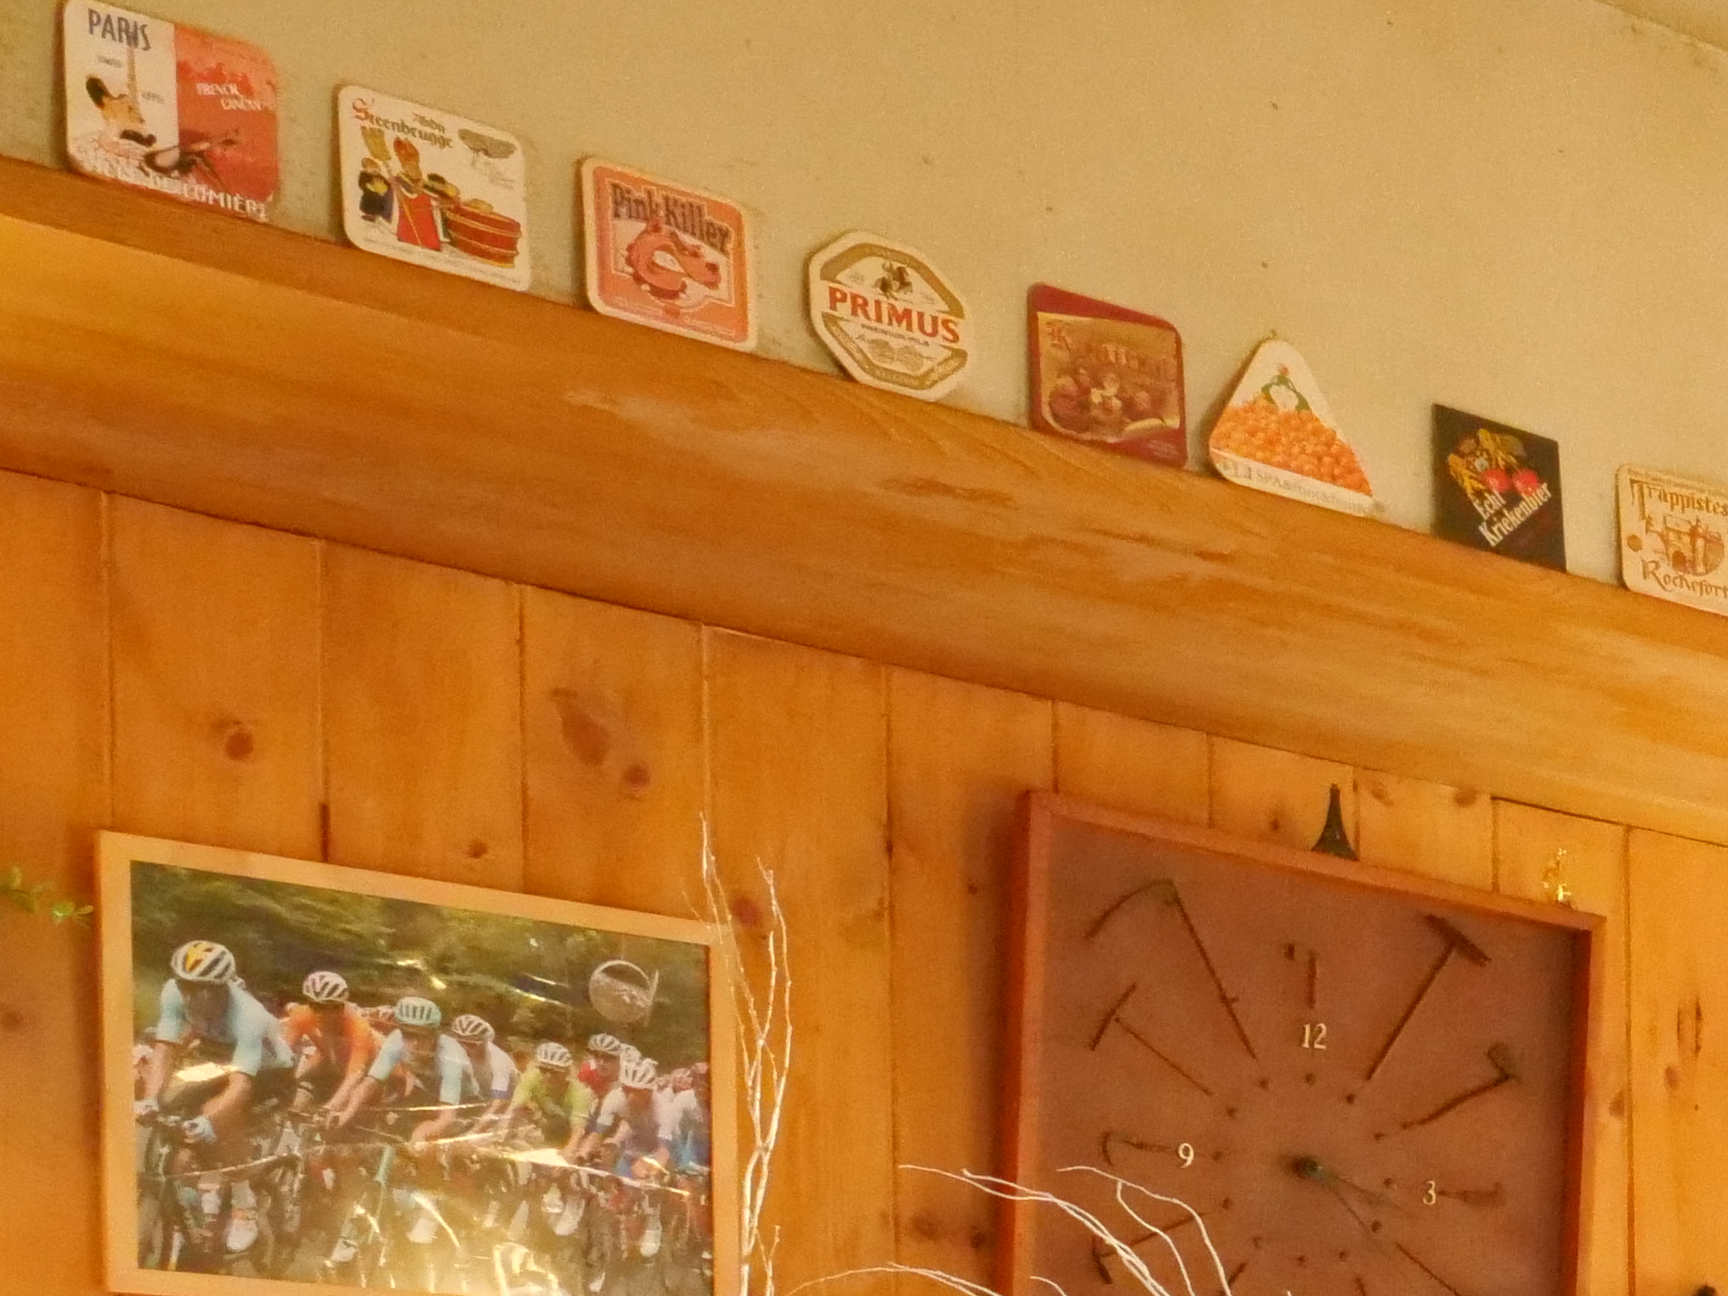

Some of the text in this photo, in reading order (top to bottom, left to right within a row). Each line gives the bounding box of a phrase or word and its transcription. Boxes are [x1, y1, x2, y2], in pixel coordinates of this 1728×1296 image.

[87, 8, 151, 51] PARIS
[611, 182, 734, 256] Pink Killer
[827, 285, 961, 345] PRIMUS
[1478, 481, 1553, 548] Kriekenbier
[1301, 1022, 1328, 1050] 12
[1177, 1142, 1195, 1169] 9
[1422, 1180, 1438, 1206] 3
